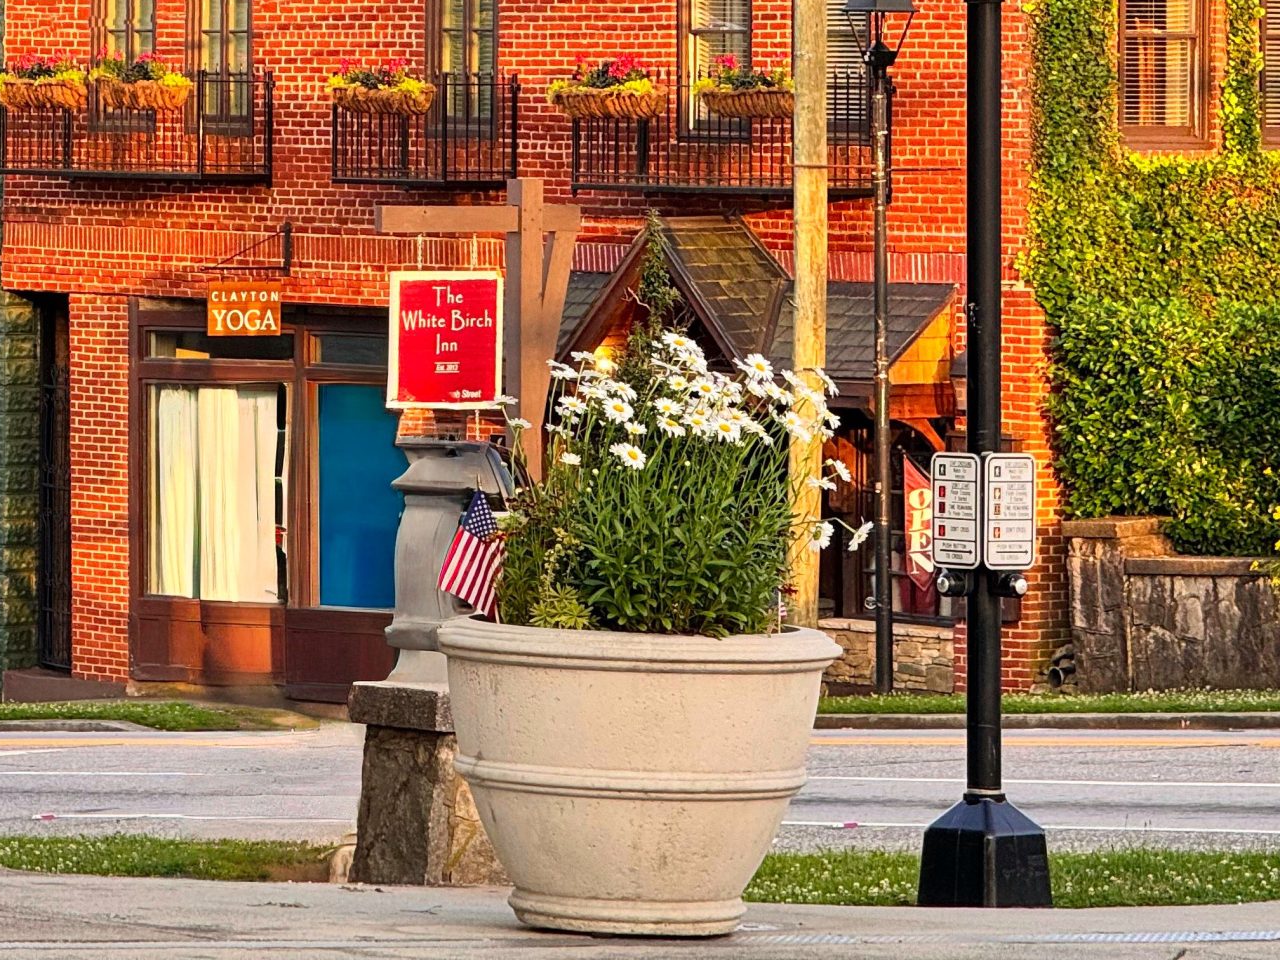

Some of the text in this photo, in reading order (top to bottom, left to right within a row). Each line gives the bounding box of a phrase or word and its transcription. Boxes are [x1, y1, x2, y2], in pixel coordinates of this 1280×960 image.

[211, 291, 280, 303] CLAYTON
[432, 286, 464, 307] The
[211, 309, 278, 331] YOGA
[401, 309, 493, 331] White Birch
[435, 333, 458, 355] Inn
[461, 389, 482, 398] Street
[908, 487, 934, 575] OPEN
